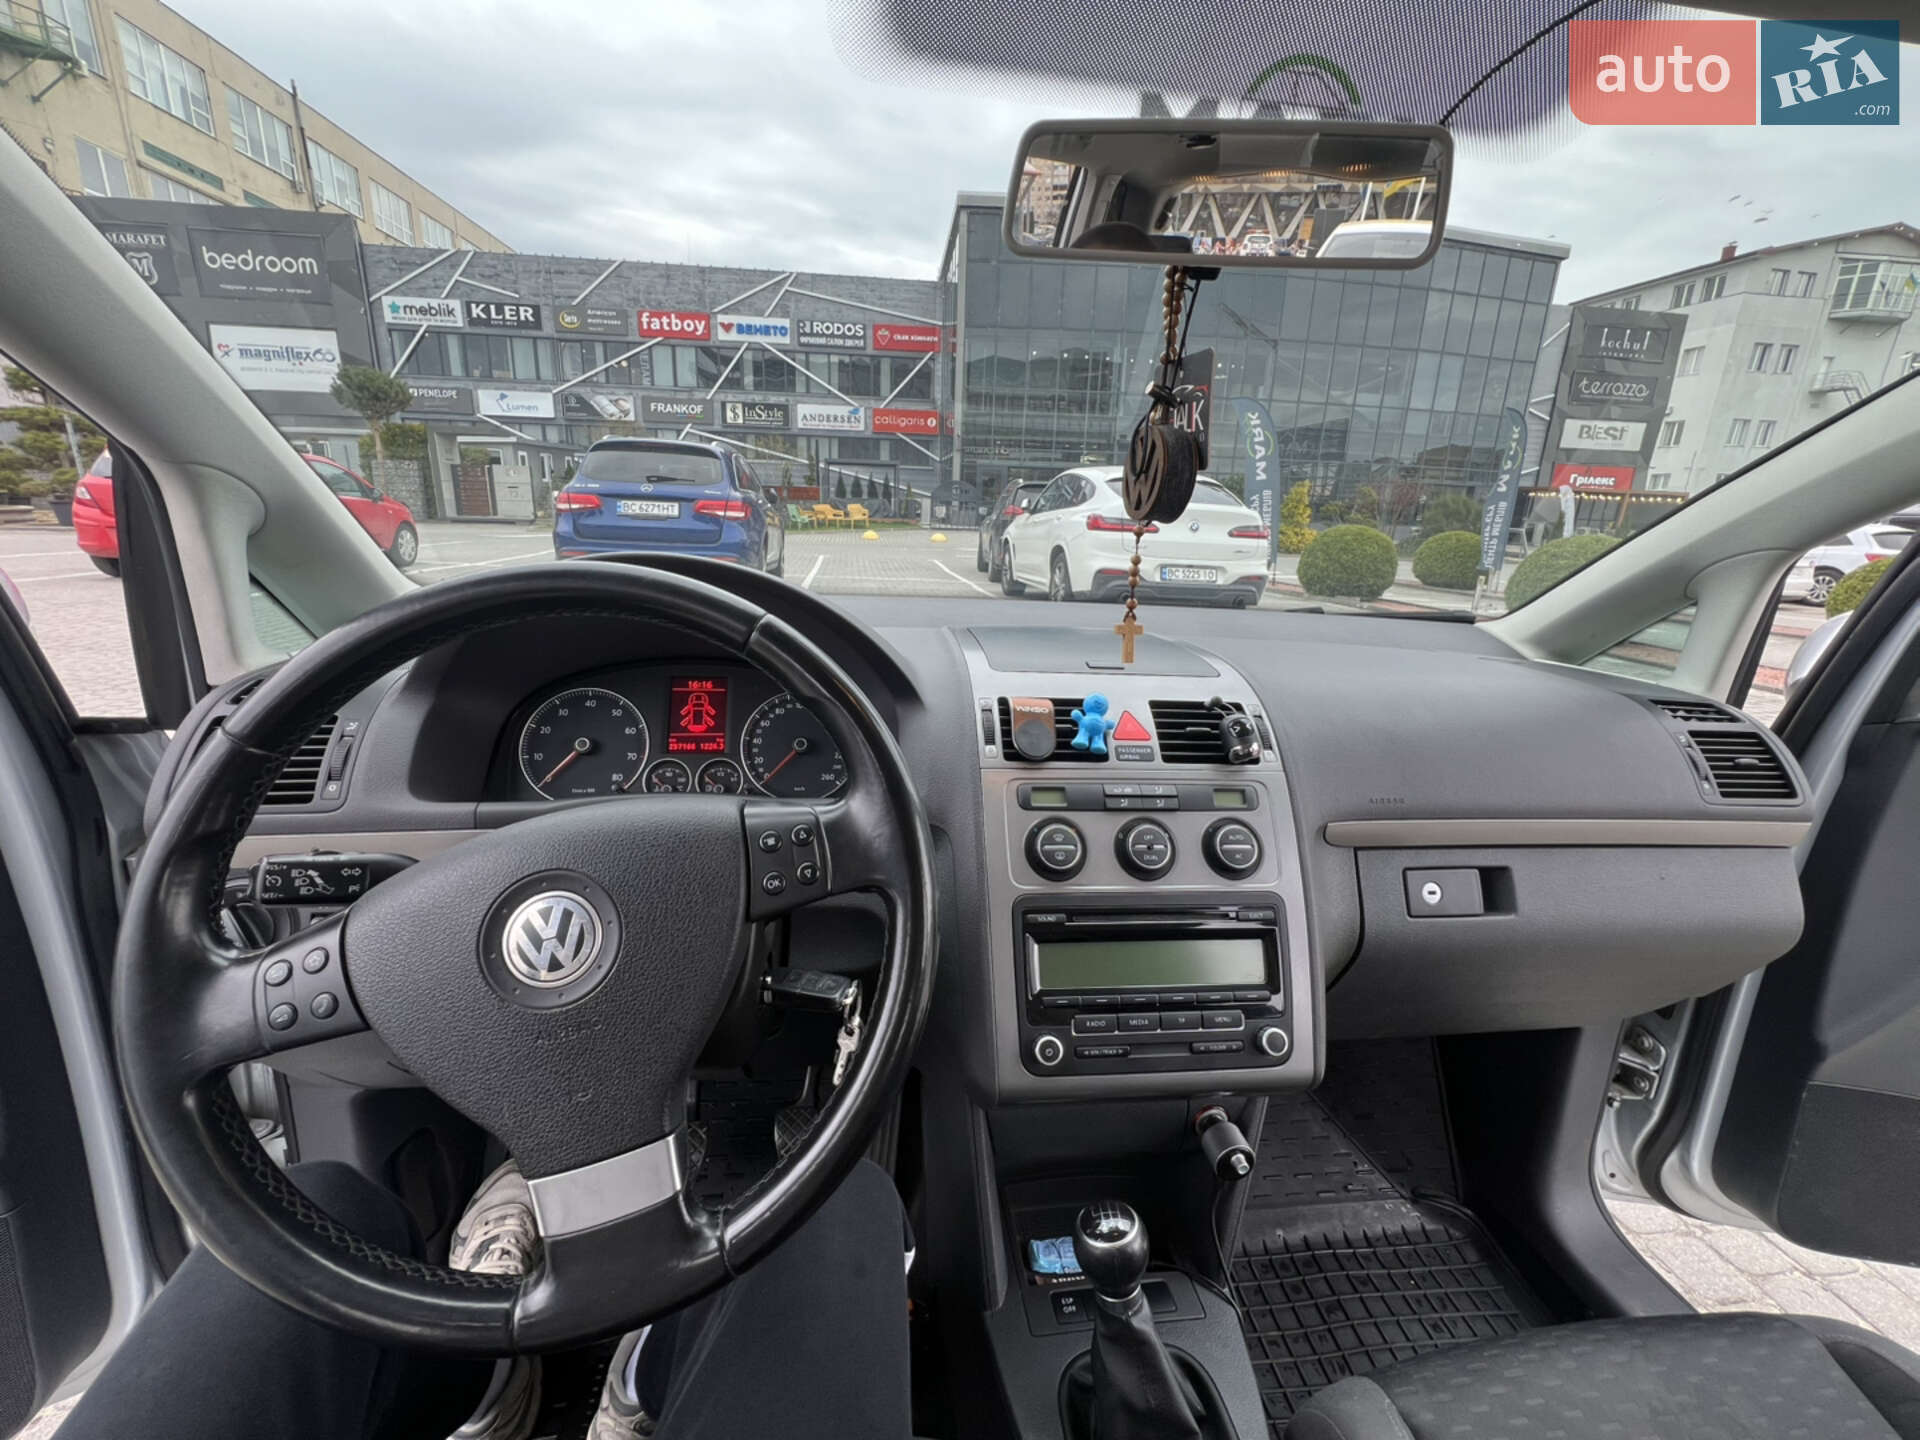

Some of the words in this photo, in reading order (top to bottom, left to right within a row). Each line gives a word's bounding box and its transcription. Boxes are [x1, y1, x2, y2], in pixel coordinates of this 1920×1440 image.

[202, 246, 318, 275] bedroom
[403, 302, 456, 318] meblik
[470, 303, 535, 321] KLER
[641, 311, 705, 336] fatboy
[813, 321, 864, 336] RODOS
[239, 346, 313, 362] magniflex
[801, 413, 862, 425] ANDERSEN
[623, 502, 637, 512] BC
[688, 680, 713, 689] 16:16
[540, 726, 551, 734] 20
[625, 727, 637, 735] 60
[627, 752, 637, 760] 70
[767, 878, 781, 888] OK
